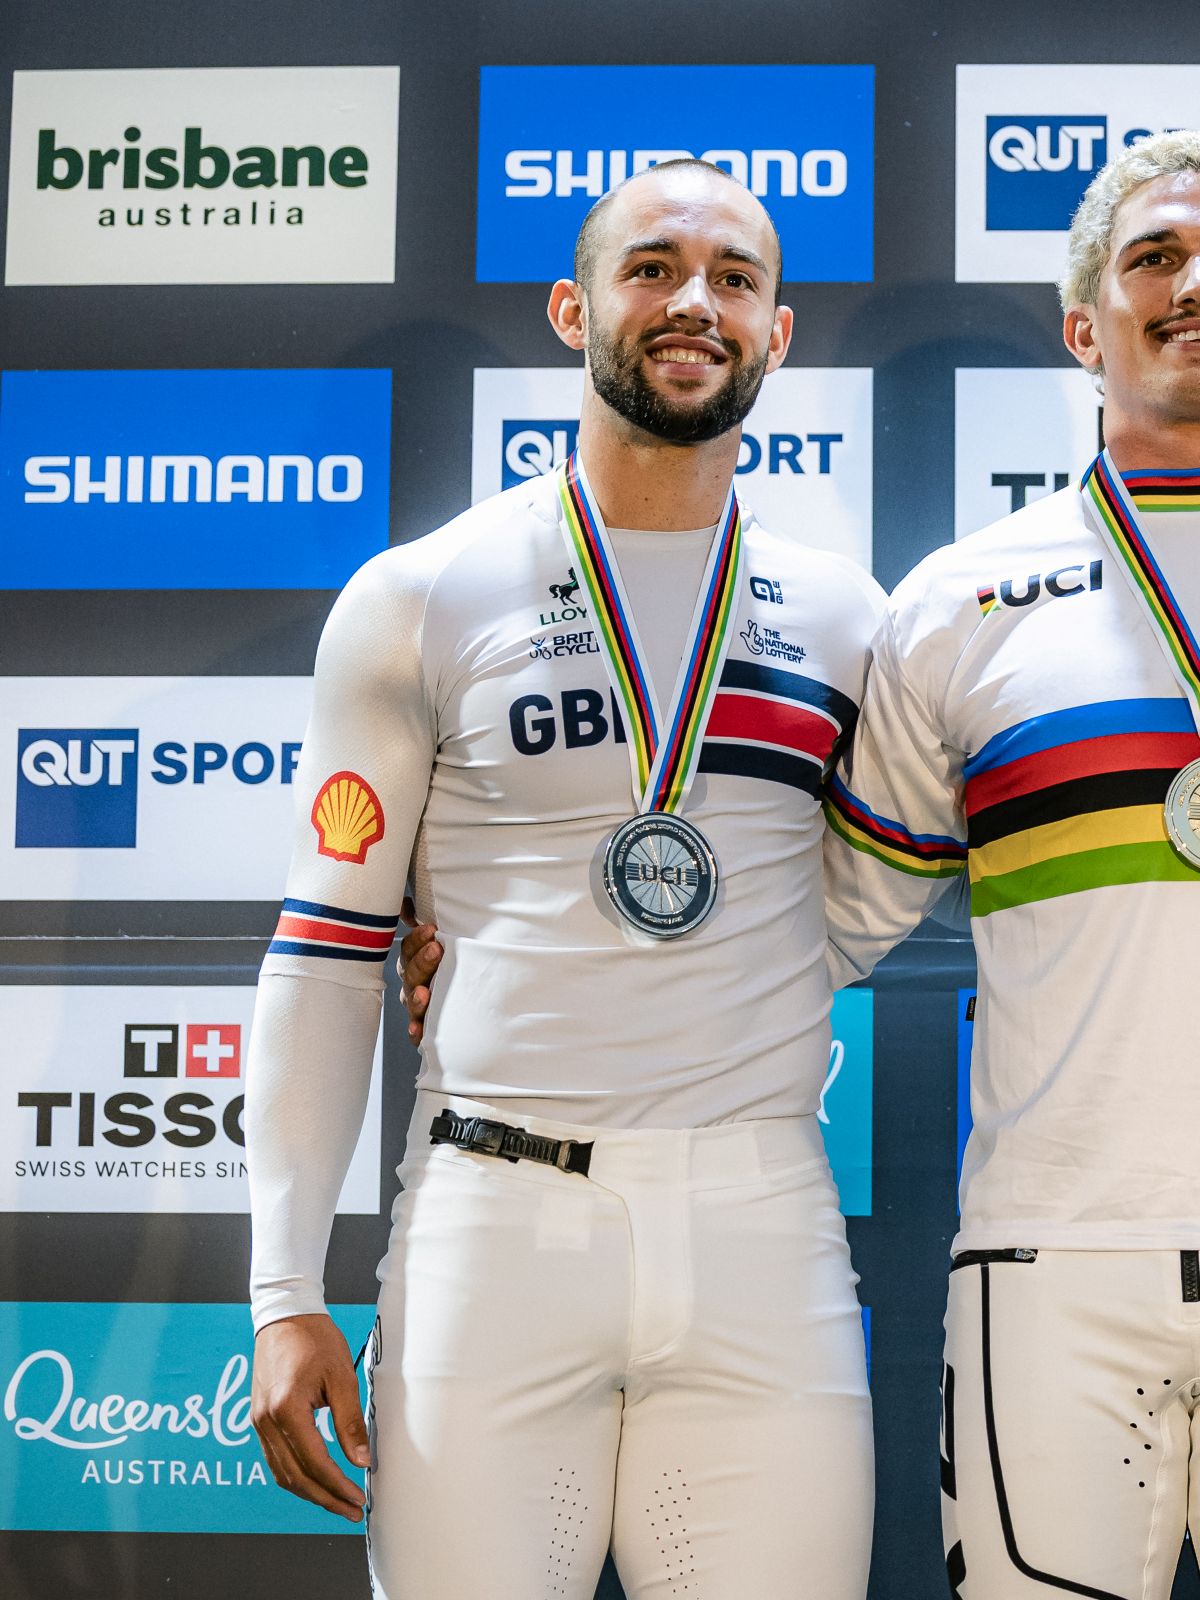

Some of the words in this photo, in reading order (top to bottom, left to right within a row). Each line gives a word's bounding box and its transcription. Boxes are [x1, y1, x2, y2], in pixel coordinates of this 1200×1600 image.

[37, 126, 369, 190] brisbane
[989, 125, 1105, 173] QUT
[505, 149, 848, 198] SHINO
[98, 201, 304, 227] australia
[735, 433, 843, 475] ORT
[24, 454, 364, 504] SHIMANO
[1000, 559, 1103, 607] UCI
[539, 606, 588, 626] LLOY
[552, 630, 597, 646] BRIT
[763, 627, 781, 640] THE
[764, 637, 807, 657] NATIONAL
[553, 640, 600, 657] CYCLI
[765, 646, 804, 664] LOTTERY
[21, 738, 135, 787] QUT
[150, 740, 304, 786] SPO
[641, 863, 682, 885] UCI
[17, 1091, 246, 1149] TISS
[15, 1160, 86, 1178] SWISS
[95, 1160, 207, 1178] WATCHES
[4, 1349, 334, 1451] Queensla
[81, 1459, 268, 1486] AUSTRALIA
